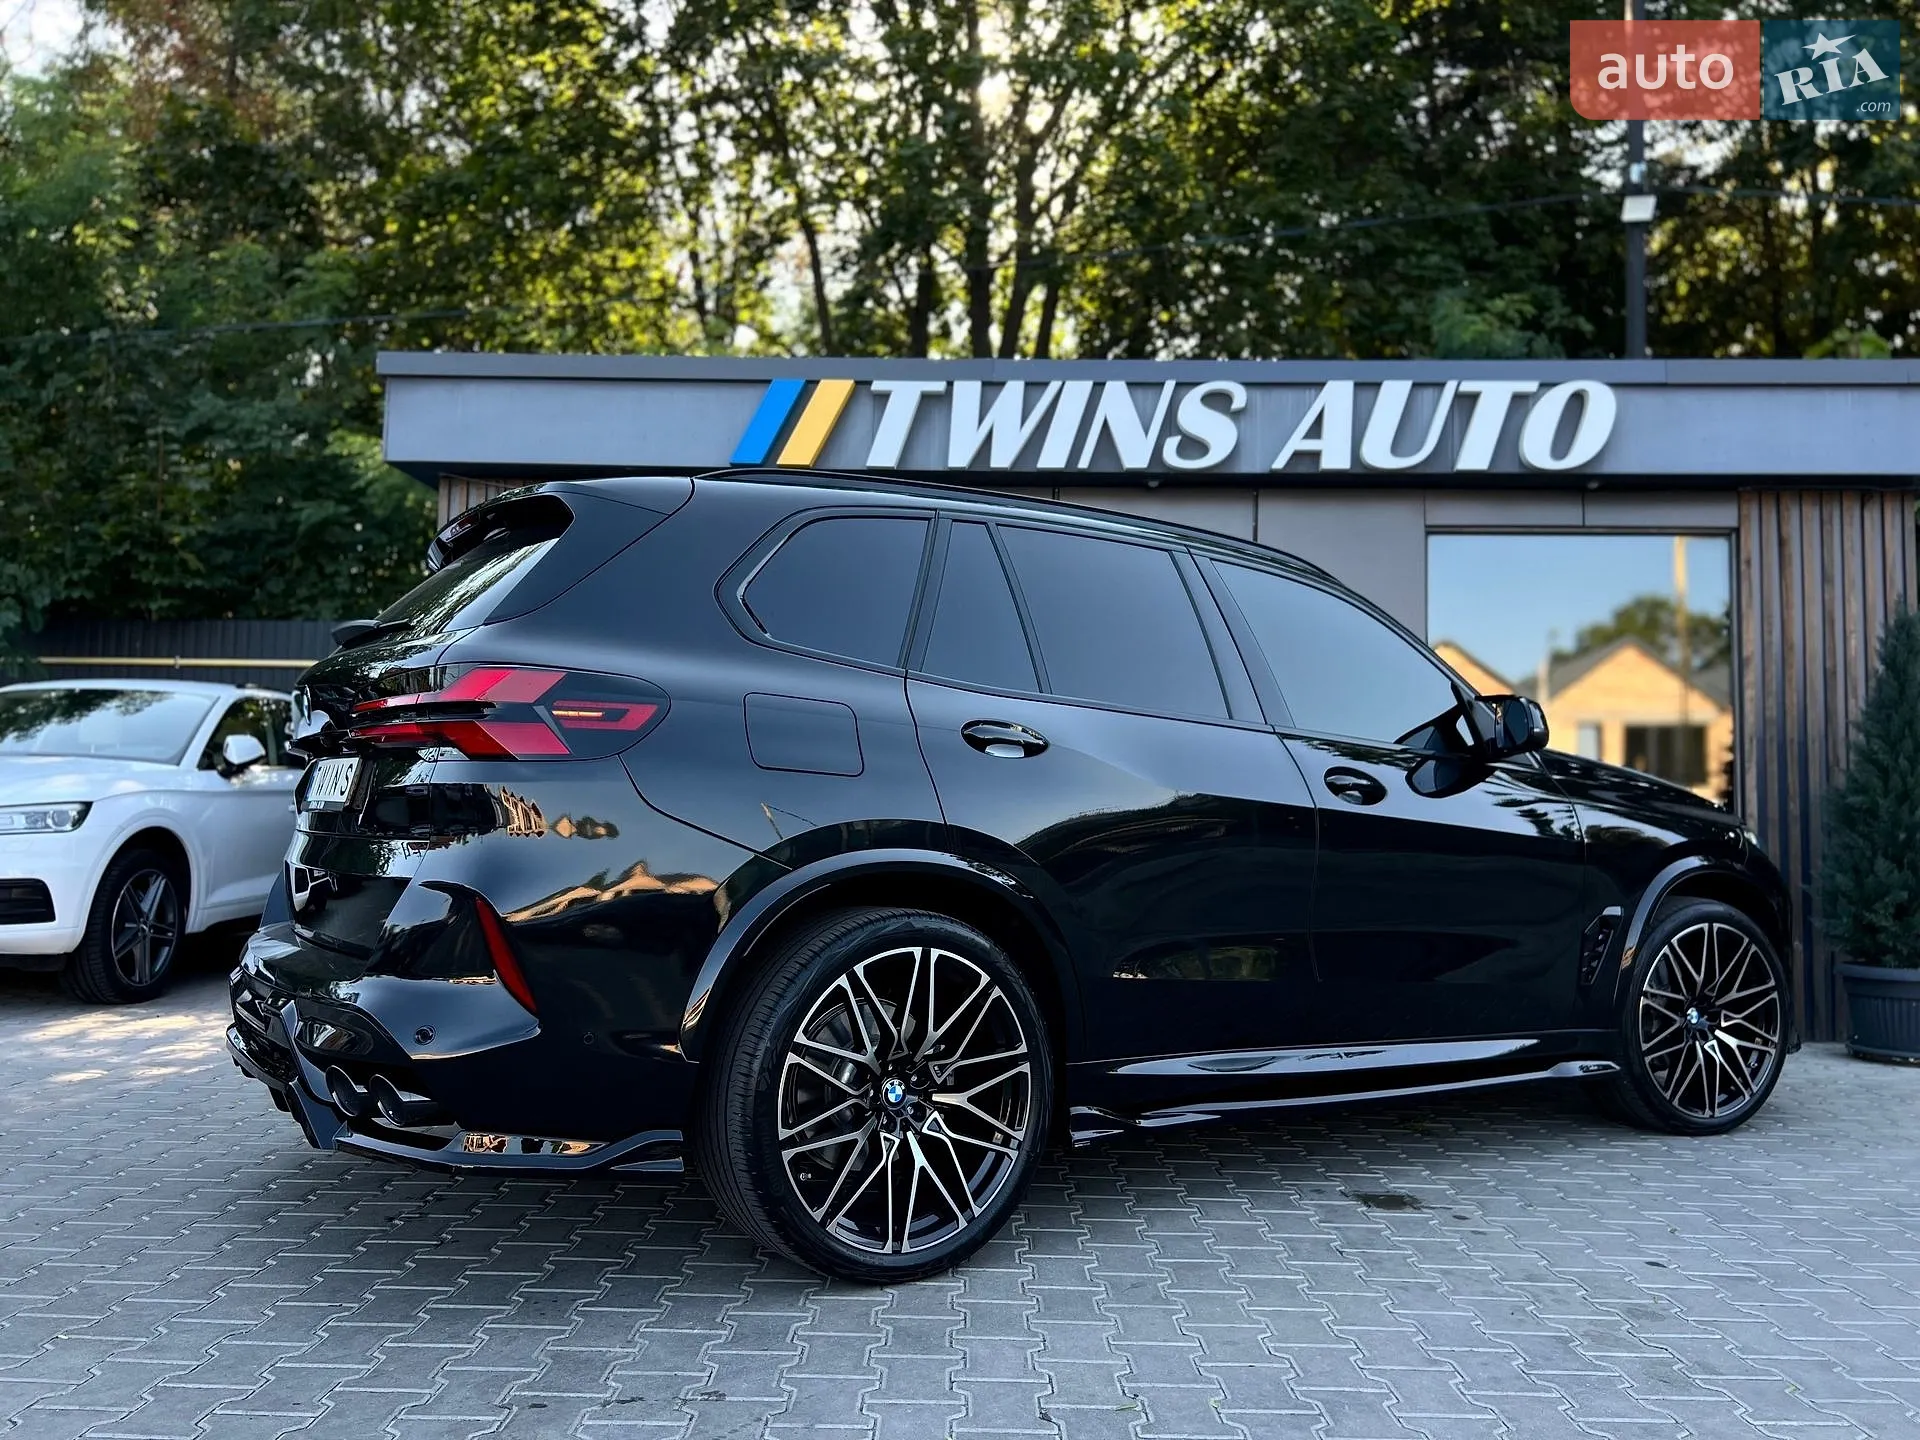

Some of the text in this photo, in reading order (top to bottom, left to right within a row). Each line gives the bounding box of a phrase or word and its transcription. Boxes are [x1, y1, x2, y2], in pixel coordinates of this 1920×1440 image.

[866, 379, 1618, 472] TWINS AUTO
[309, 763, 353, 797] TWINS
